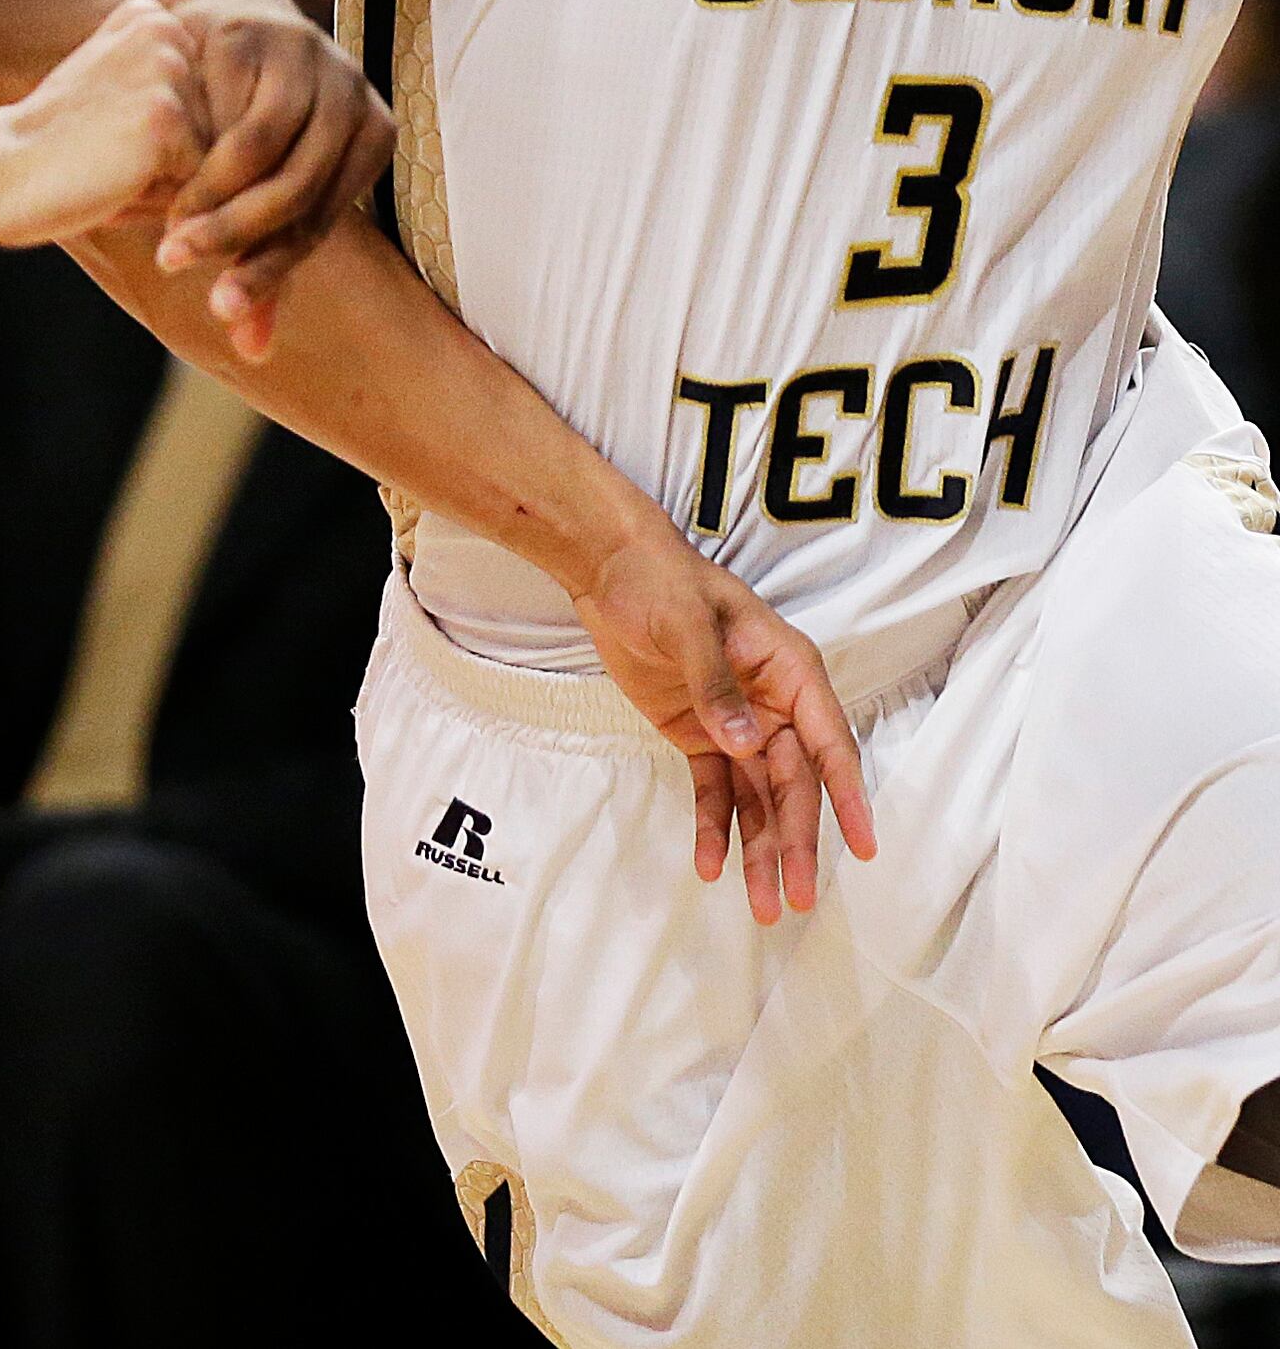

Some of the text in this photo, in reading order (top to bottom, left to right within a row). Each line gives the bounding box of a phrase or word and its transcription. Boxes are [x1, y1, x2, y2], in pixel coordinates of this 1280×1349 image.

[836, 73, 993, 311] 3
[673, 339, 1059, 539] TECH
[415, 840, 505, 886] RUSSELL
[431, 796, 493, 862] R
